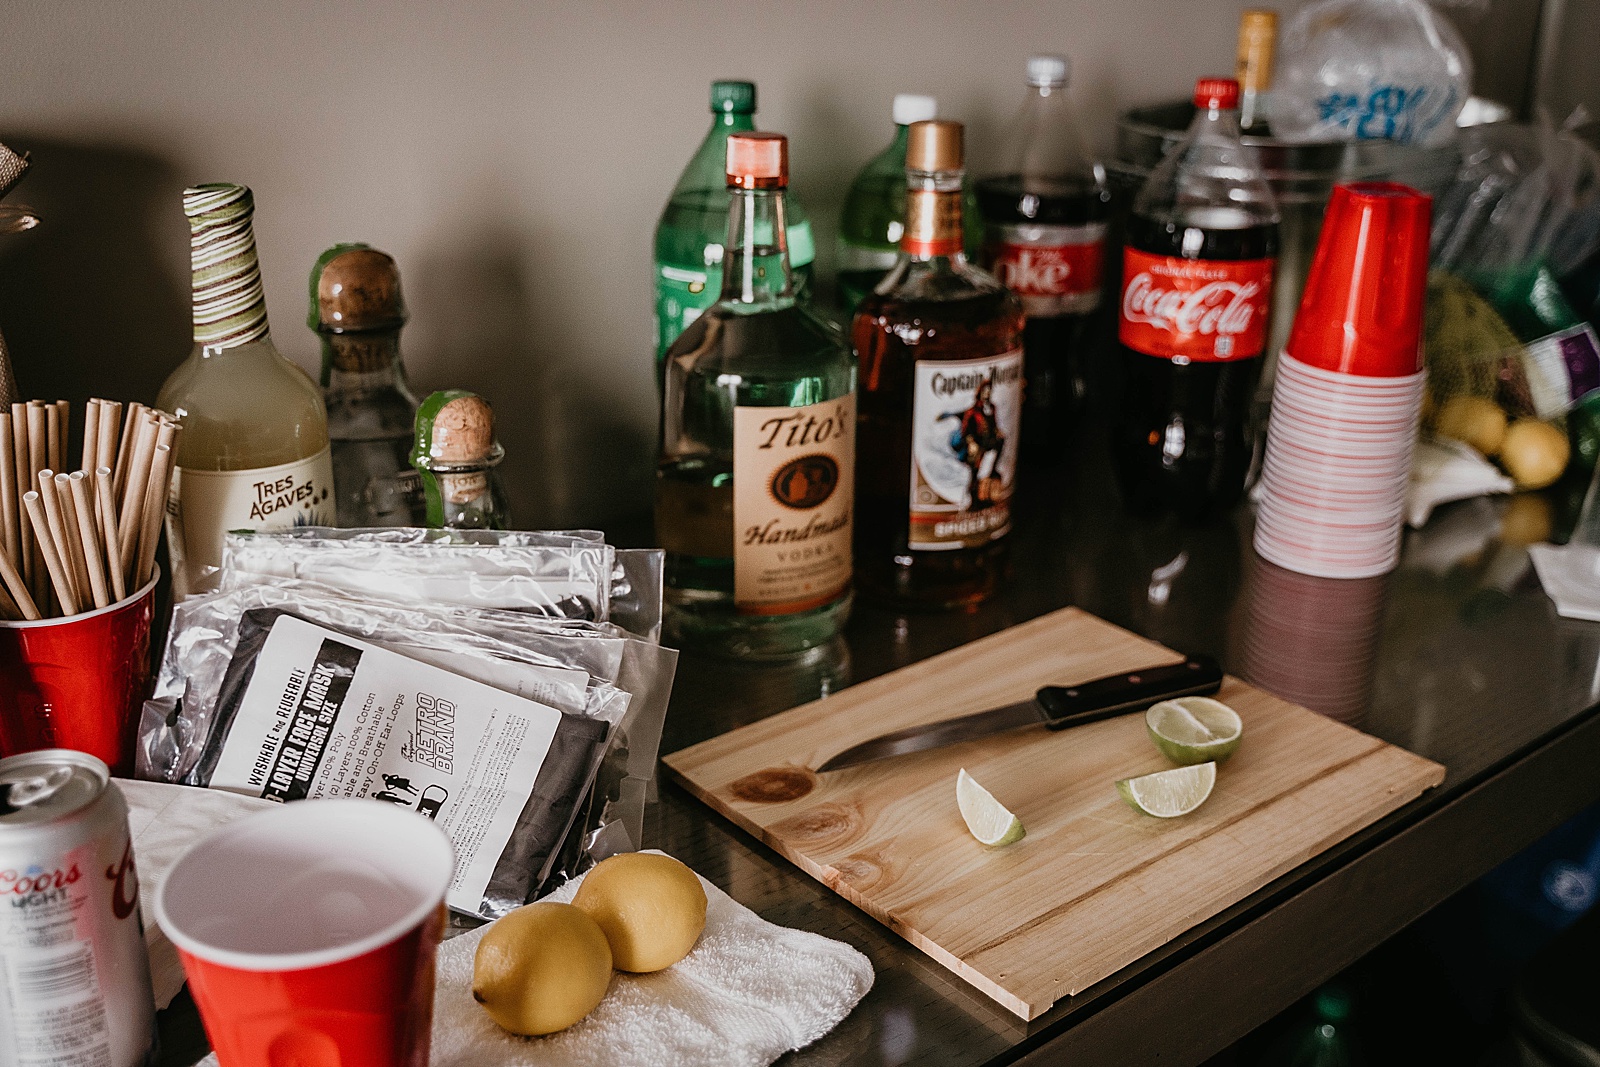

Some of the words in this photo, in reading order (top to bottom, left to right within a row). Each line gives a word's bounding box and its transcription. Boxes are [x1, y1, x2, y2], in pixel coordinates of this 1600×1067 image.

[993, 250, 1071, 294] oke
[931, 371, 984, 398] Captain
[759, 404, 848, 449] Tito's
[250, 481, 313, 521] AGAVES
[253, 475, 293, 504] TRES
[276, 667, 305, 719] REUSEABLE
[288, 710, 317, 747] FACE
[303, 664, 336, 711] MASK
[356, 692, 376, 724] Cotton
[272, 720, 286, 733] and
[295, 725, 329, 781] UNIVERSAL
[318, 700, 338, 724] SIZE
[347, 726, 363, 751] 100%
[355, 776, 374, 799] Easy
[366, 740, 386, 775] On-Off
[379, 722, 393, 740] Ear
[386, 693, 405, 722] Loops
[358, 706, 385, 757] Breathable
[415, 691, 436, 768] RETRO
[434, 697, 455, 775] BRAND
[248, 734, 279, 786] WASHABLE
[312, 780, 326, 800] ayer
[320, 755, 336, 780] 100%
[329, 732, 347, 754] Poly
[333, 751, 353, 784] Layers
[352, 757, 365, 777] and
[328, 784, 341, 796] (2)
[0, 865, 81, 894] Coors
